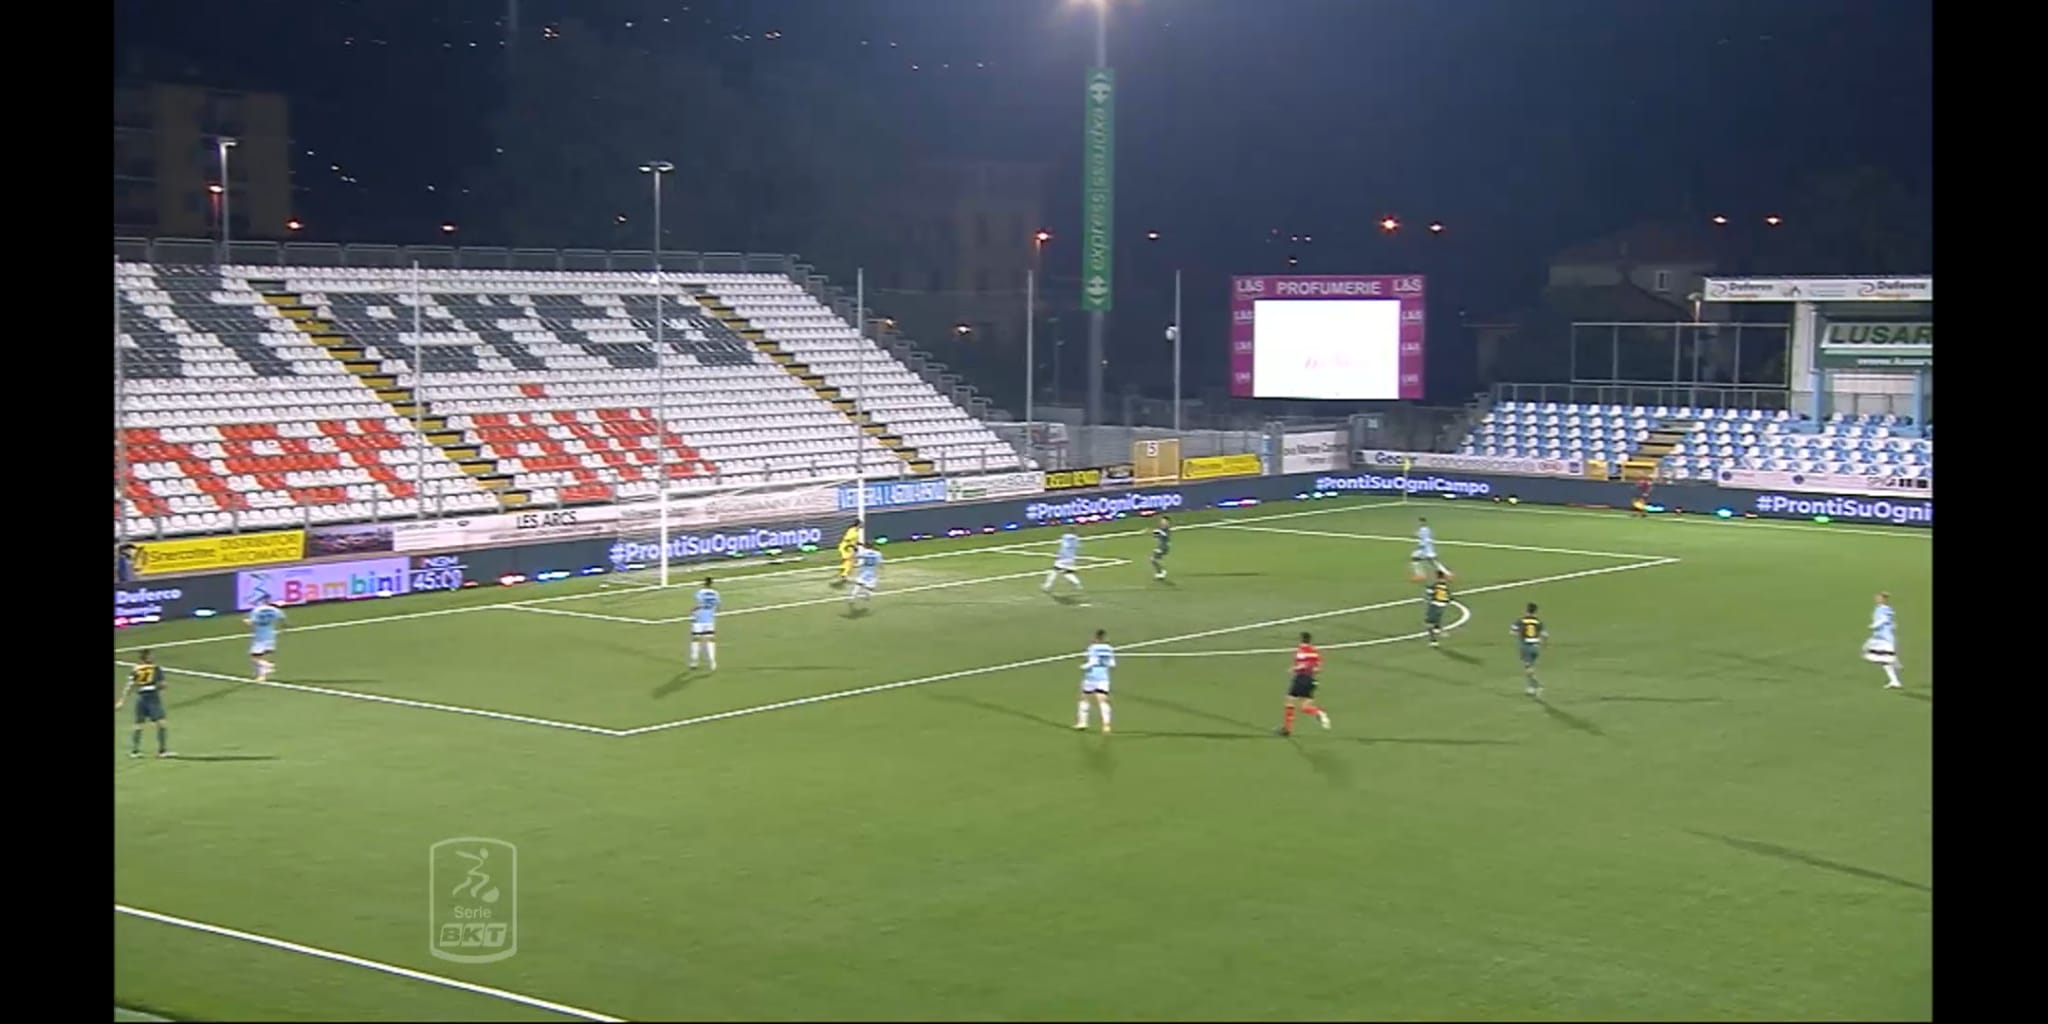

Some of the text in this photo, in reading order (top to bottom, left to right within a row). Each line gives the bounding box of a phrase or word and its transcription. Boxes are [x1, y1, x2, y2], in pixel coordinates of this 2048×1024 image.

[1089, 108, 1106, 187] express
[1091, 193, 1107, 271] express
[1235, 280, 1265, 293] L&S
[1276, 281, 1382, 295] PROFUMERIE
[1393, 278, 1422, 293] L&S
[1315, 474, 1489, 495] #ProntiSuOgniCampo
[1026, 493, 1182, 519] #ProntiSuOgniCampo
[1756, 496, 1932, 523] #ProntiSuOgni
[516, 510, 578, 530] LES ARCS
[609, 527, 821, 565] #ProntiSuOgniCampo
[114, 587, 182, 605] Duferco
[284, 569, 403, 604] Bambini
